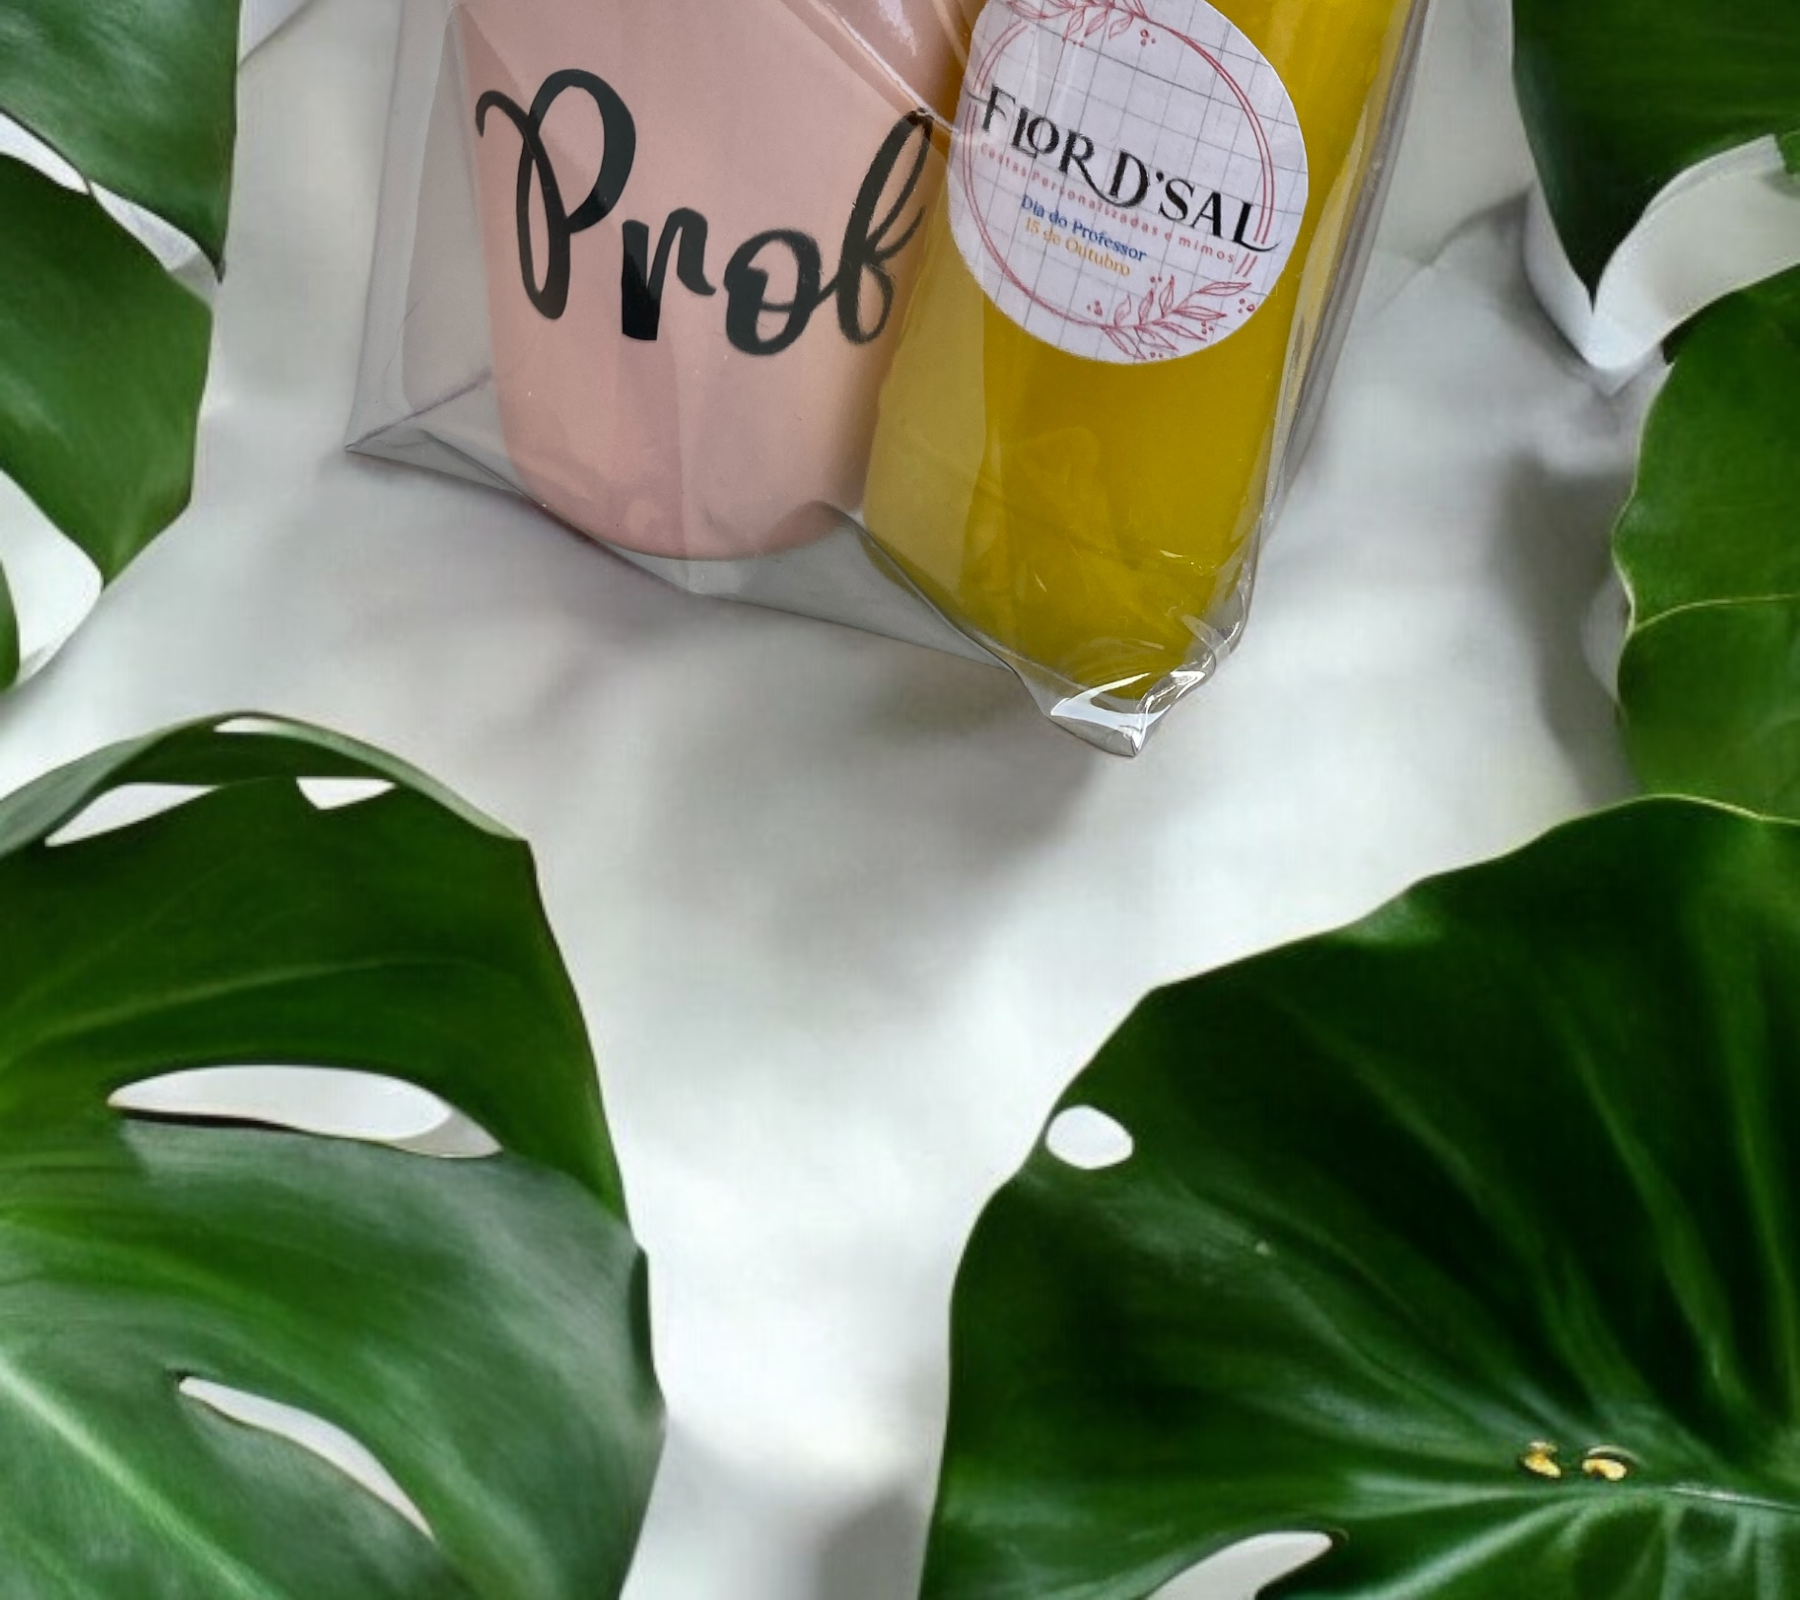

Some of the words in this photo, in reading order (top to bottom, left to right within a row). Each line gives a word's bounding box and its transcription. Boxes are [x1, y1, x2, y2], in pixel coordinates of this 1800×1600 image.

[967, 84, 1112, 205] FLOR
[1108, 150, 1283, 252] D'SAL
[475, 68, 934, 356] Prof
[1021, 194, 1045, 218] Dia
[1049, 210, 1068, 228] do
[1072, 219, 1147, 262] Professor
[1025, 216, 1040, 234] 15
[1043, 228, 1060, 245] de
[1065, 237, 1130, 277] Outubro
[1179, 236, 1235, 264] mimos
